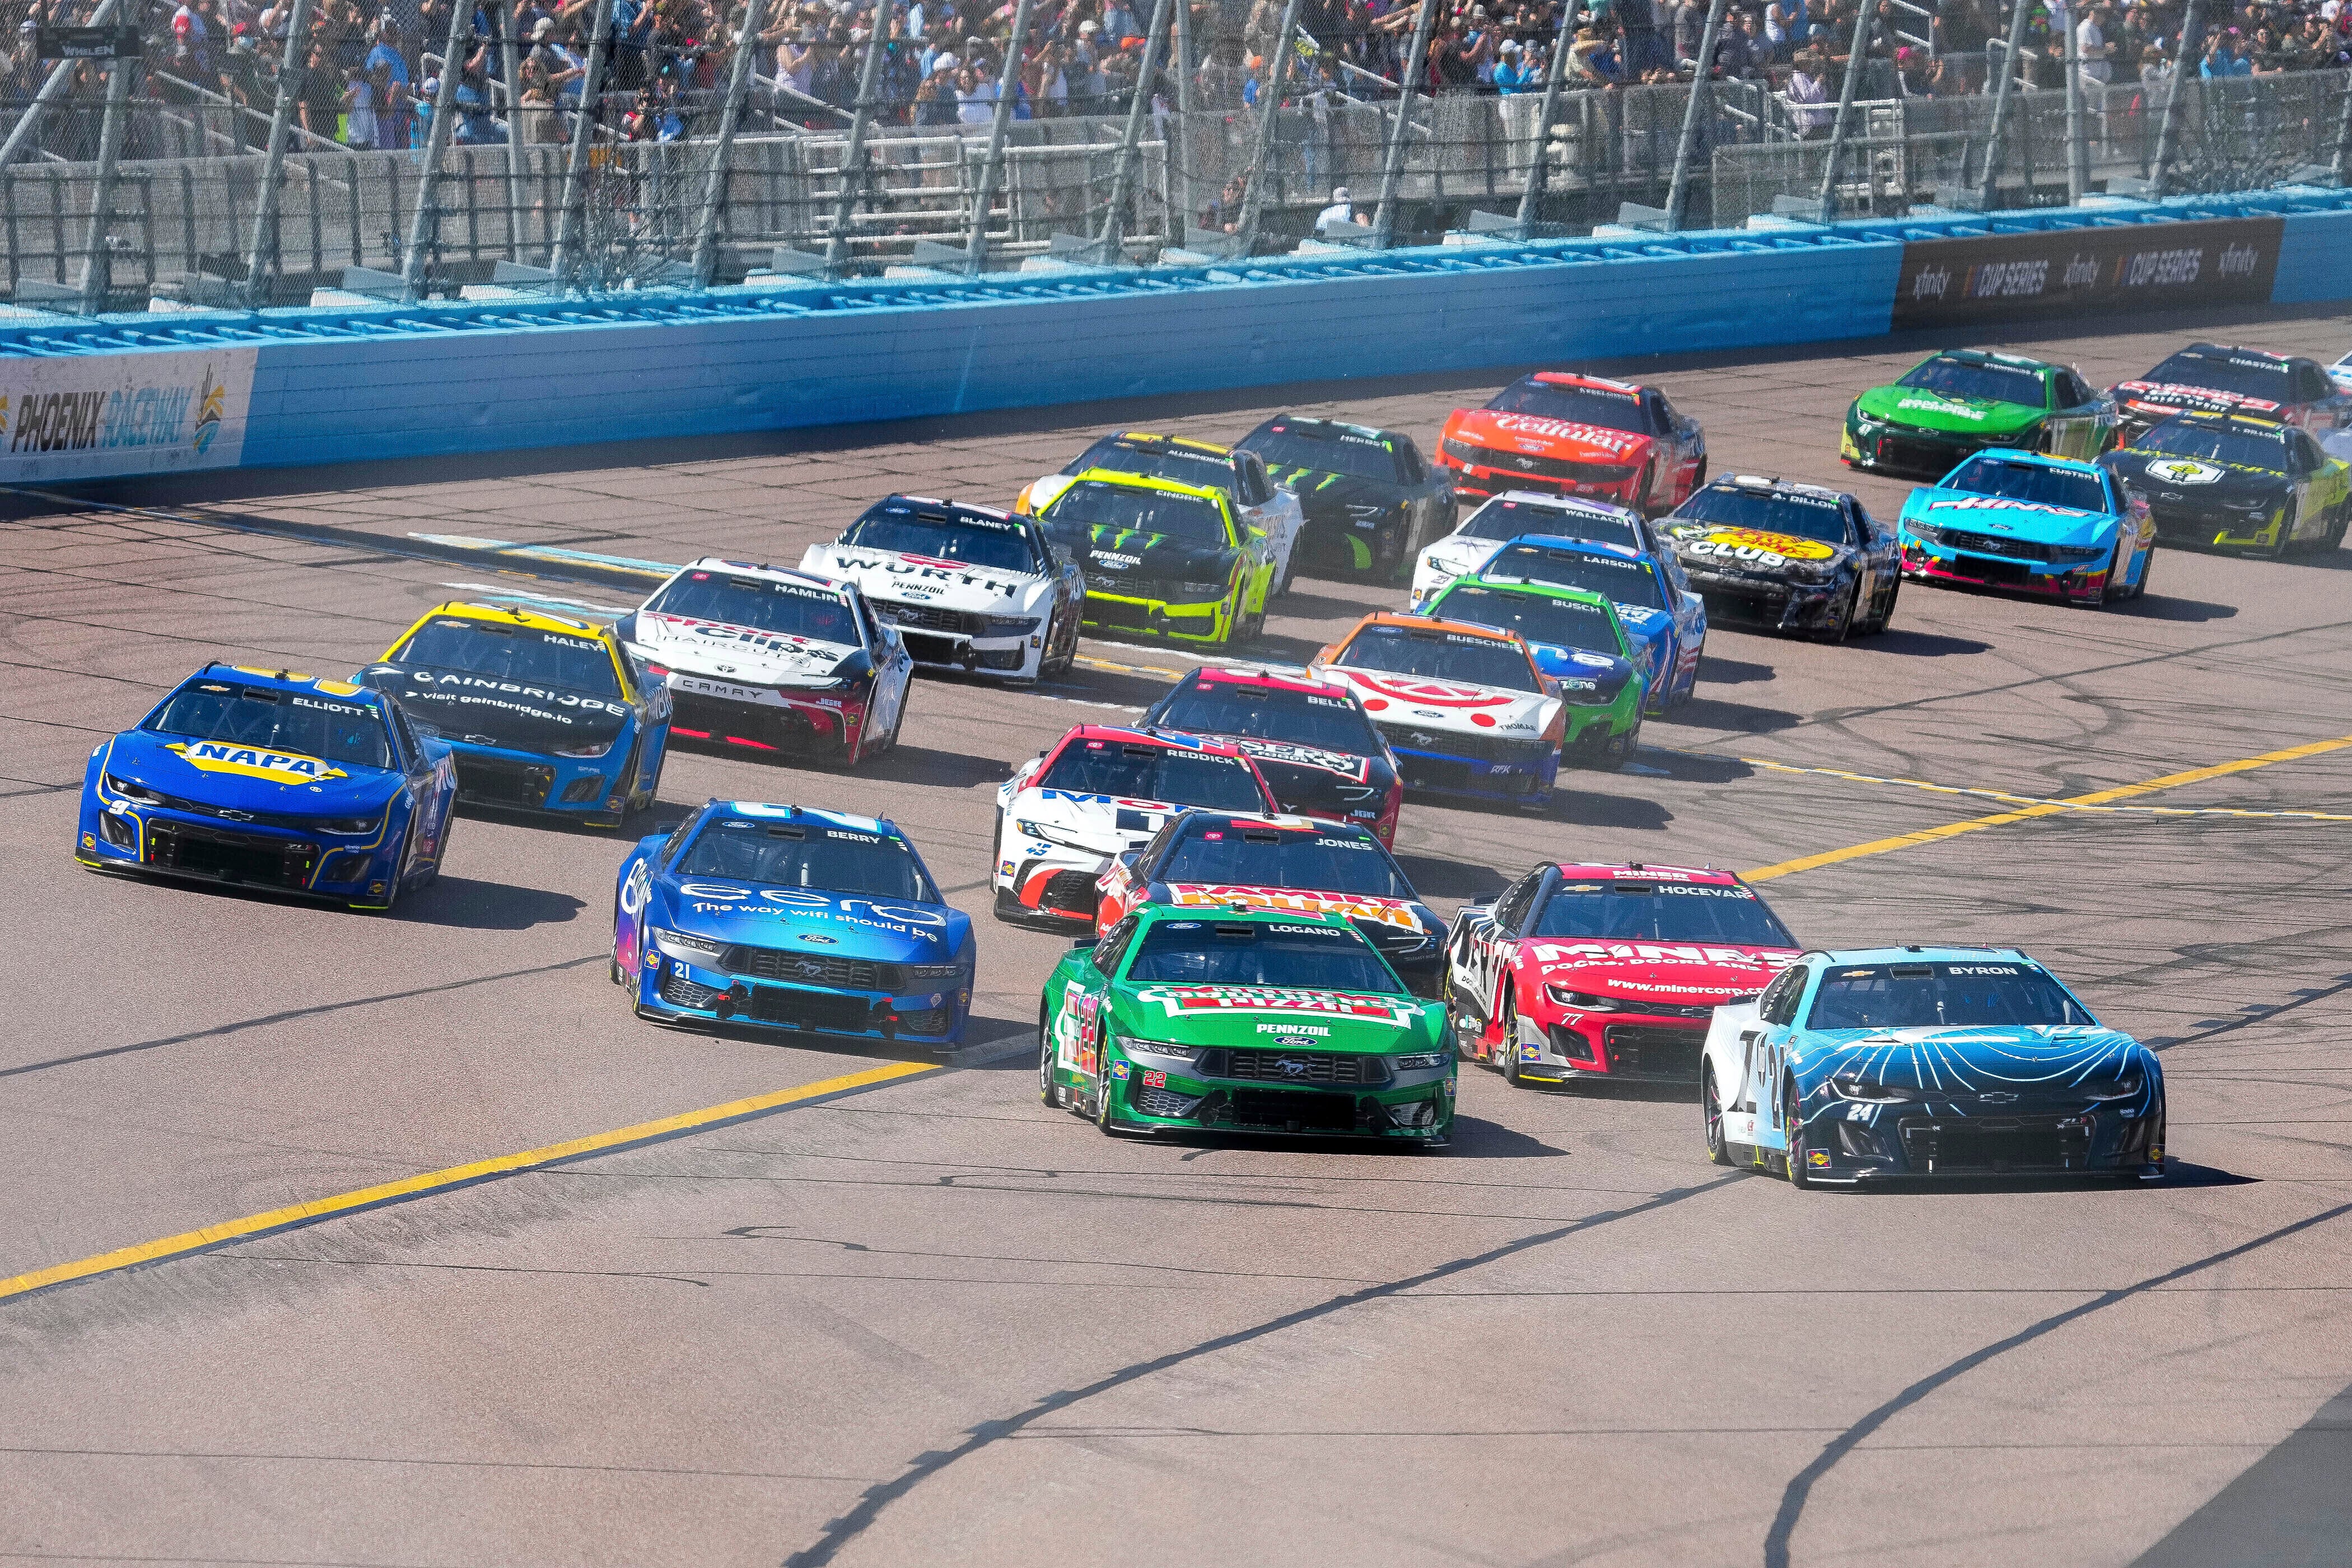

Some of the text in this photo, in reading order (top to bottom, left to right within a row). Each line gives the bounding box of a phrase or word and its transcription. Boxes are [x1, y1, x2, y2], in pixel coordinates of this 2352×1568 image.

[2129, 248, 2204, 287] CUP SERIES
[1977, 259, 2049, 297] CUP SERIES
[11, 391, 106, 453] PHOENIX
[1496, 418, 1633, 455] Cellular
[1156, 489, 1203, 503] CINDRIC
[1771, 492, 1838, 510] A. DILLON
[960, 516, 1011, 531] BLANEY
[1565, 509, 1624, 525] WALLACE
[1089, 549, 1141, 566] PENNZOIL
[1689, 541, 1786, 568] CLUB
[1583, 556, 1637, 571] LARSON
[775, 584, 838, 603] HAMLIN
[892, 581, 945, 595] PENNZOIL
[1552, 599, 1601, 614] BUSCH
[544, 634, 599, 651] HALEY
[663, 635, 807, 667] HAIRCUTS
[413, 671, 627, 717] GAINBRIDGE
[683, 679, 763, 699] CAMRY
[292, 697, 365, 716] ELLIOTT
[422, 692, 573, 725] visit gainbridge.io
[816, 698, 843, 708] JGR
[1308, 695, 1347, 709] BELL
[1500, 722, 1537, 731] THOMAS
[197, 743, 315, 776] NAPA
[1167, 749, 1235, 766] REDDICK
[108, 799, 131, 815] 9
[827, 830, 880, 844] BERRY
[1315, 837, 1373, 851] JONES
[1612, 870, 1690, 879] MINER
[1658, 885, 1749, 899] HOCEVAR
[679, 883, 947, 927] eero
[692, 902, 938, 943] The way wifi should be
[1269, 924, 1341, 937] LOGANO
[674, 962, 690, 979] 21
[1541, 959, 1625, 976] DOCKS,
[1715, 962, 1762, 972] AND
[1949, 967, 2018, 976] BYRON
[1561, 1012, 1585, 1026] 77
[1256, 1023, 1331, 1037] PENNZOIL
[1143, 1070, 1167, 1088] 22
[1846, 1103, 1876, 1122] 24
